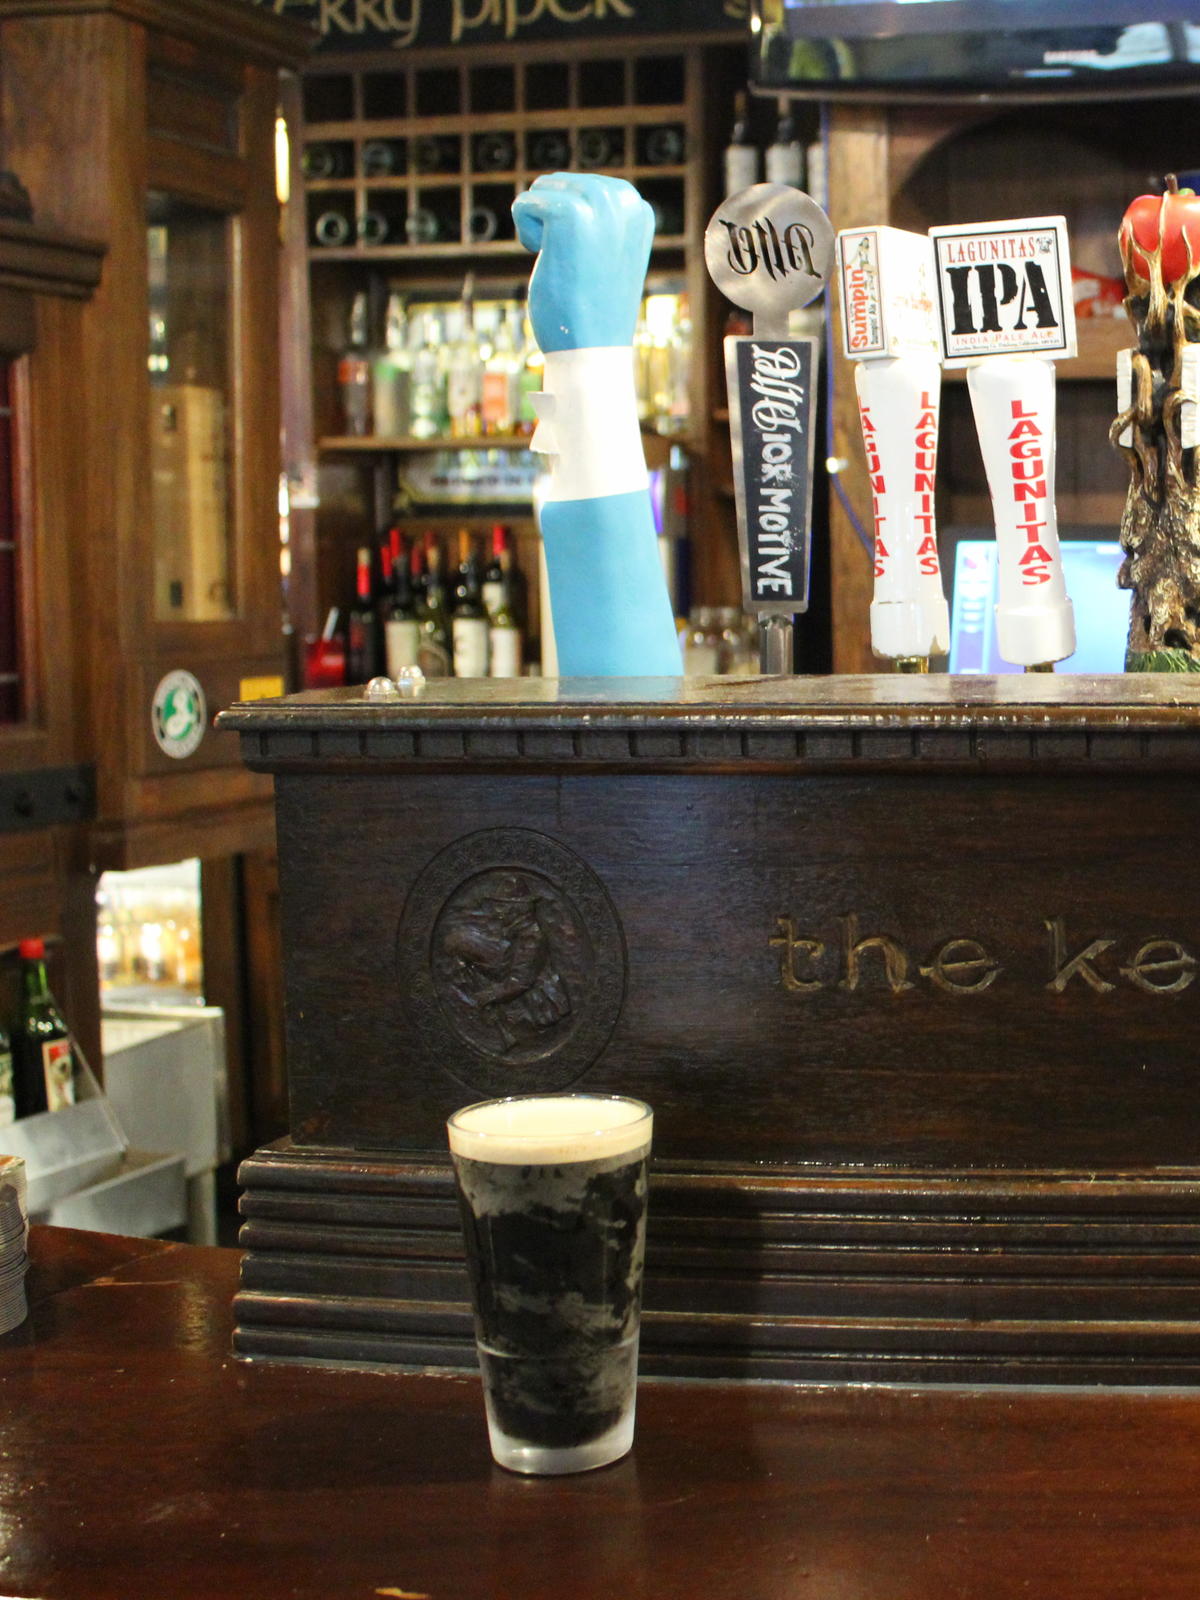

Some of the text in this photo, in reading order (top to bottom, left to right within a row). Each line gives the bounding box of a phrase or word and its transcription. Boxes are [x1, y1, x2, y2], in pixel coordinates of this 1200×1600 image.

[946, 236, 1036, 263] LAGUNITAS
[945, 260, 1060, 335] IPA
[914, 391, 939, 576] LAGUNITAS
[1007, 400, 1053, 585] LAGUNITAS
[756, 487, 794, 596] MOTIVE
[768, 912, 1002, 994] the
